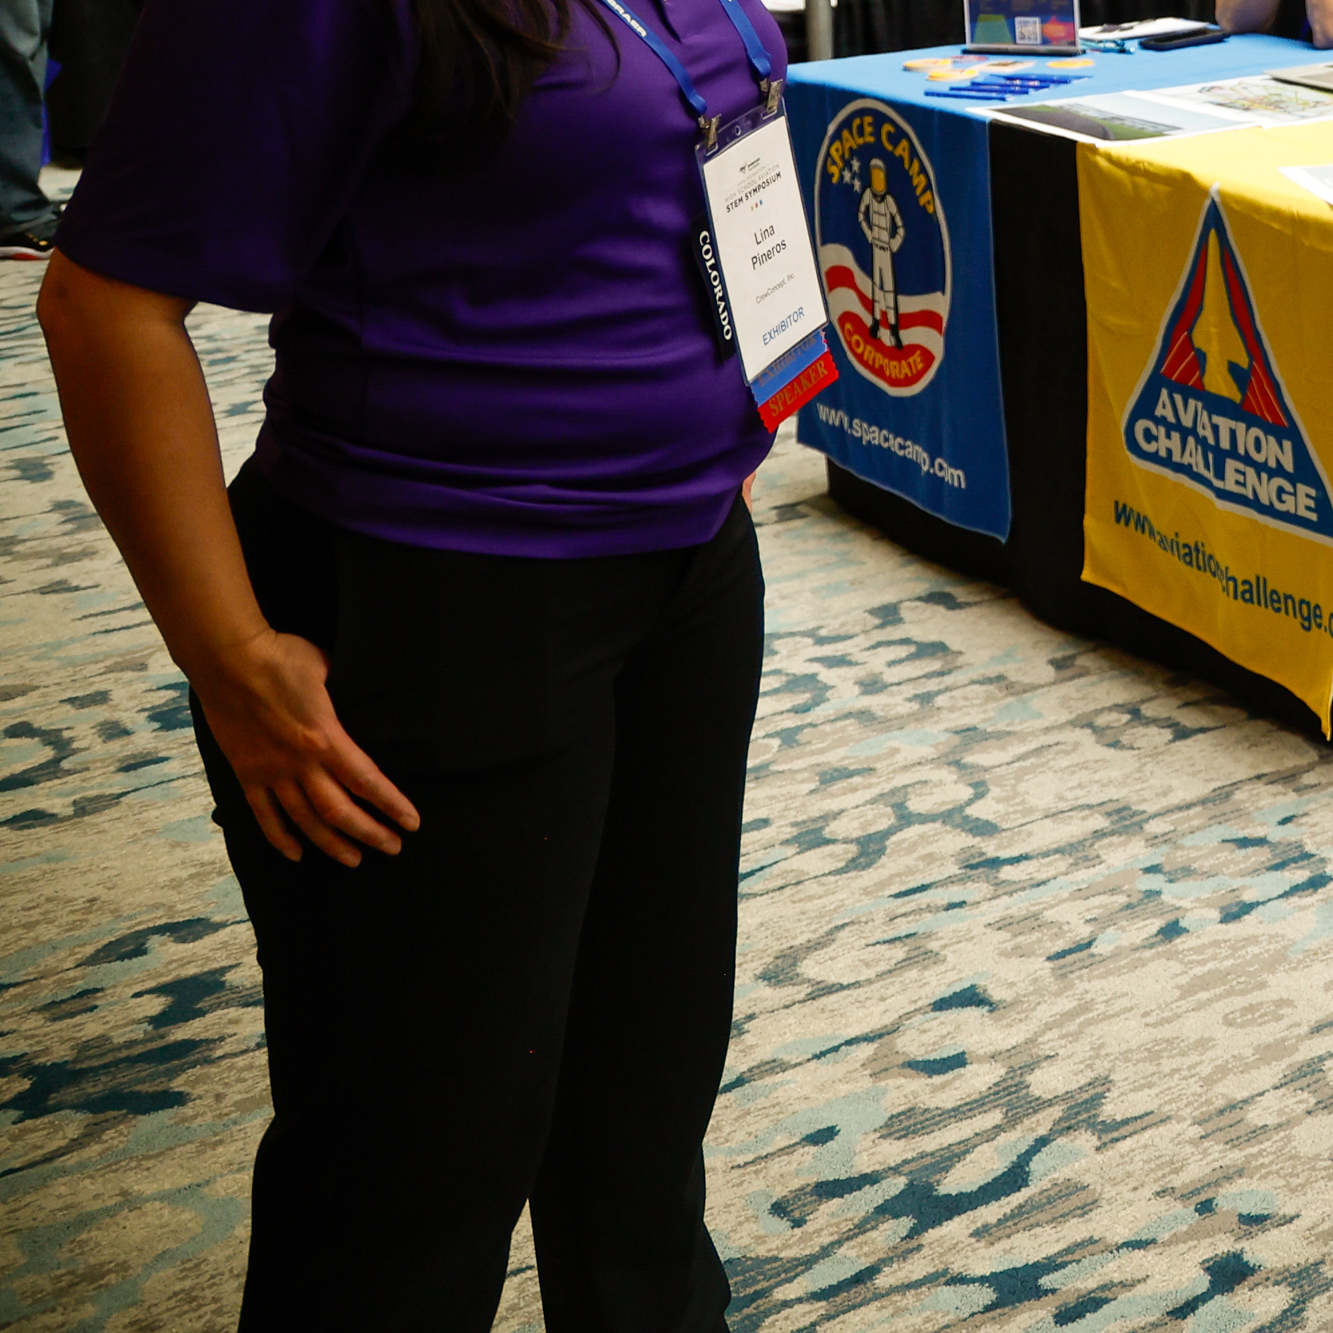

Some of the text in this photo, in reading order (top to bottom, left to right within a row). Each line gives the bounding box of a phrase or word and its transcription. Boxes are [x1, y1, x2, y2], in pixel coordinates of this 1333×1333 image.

[726, 196, 743, 213] STEM
[745, 171, 782, 201] SYMPOSIUM
[826, 116, 935, 217] SPACE CAMP
[751, 239, 787, 270] Pineros
[754, 225, 775, 245] Lina
[699, 230, 732, 341] COLORADO
[762, 307, 805, 346] EXHIBITOR
[844, 320, 925, 380] CORPORATE
[768, 359, 828, 417] SPEAKER
[1153, 388, 1294, 474] AVIATION
[1134, 419, 1318, 523] CHALLENGE
